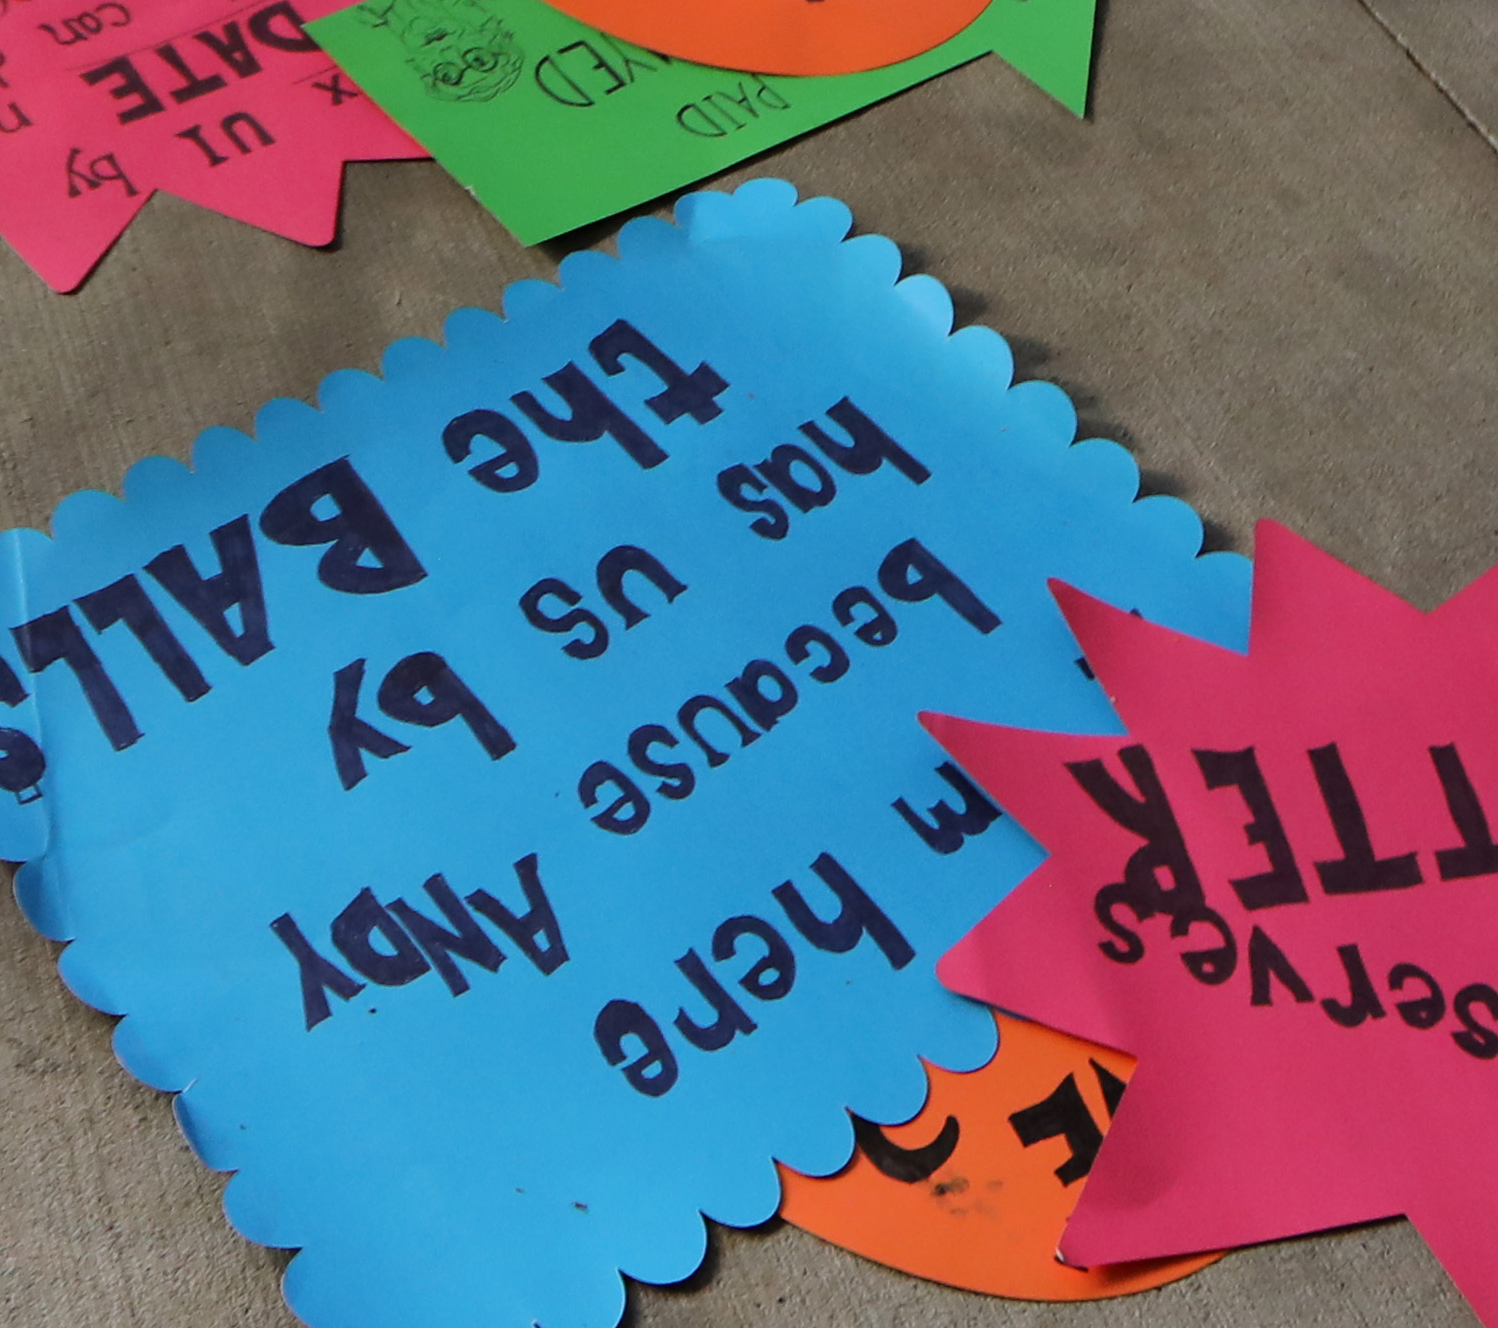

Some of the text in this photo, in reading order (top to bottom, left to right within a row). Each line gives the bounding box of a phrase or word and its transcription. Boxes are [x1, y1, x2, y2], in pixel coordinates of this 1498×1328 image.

[36, 1, 130, 47] can
[531, 33, 671, 108] YED
[673, 75, 790, 139] PAID
[64, 147, 137, 198] by
[173, 110, 274, 166] UI
[439, 318, 730, 494] the
[325, 395, 931, 790] has us by
[267, 536, 1000, 1031] because ANDY
[591, 761, 999, 1097] m here
